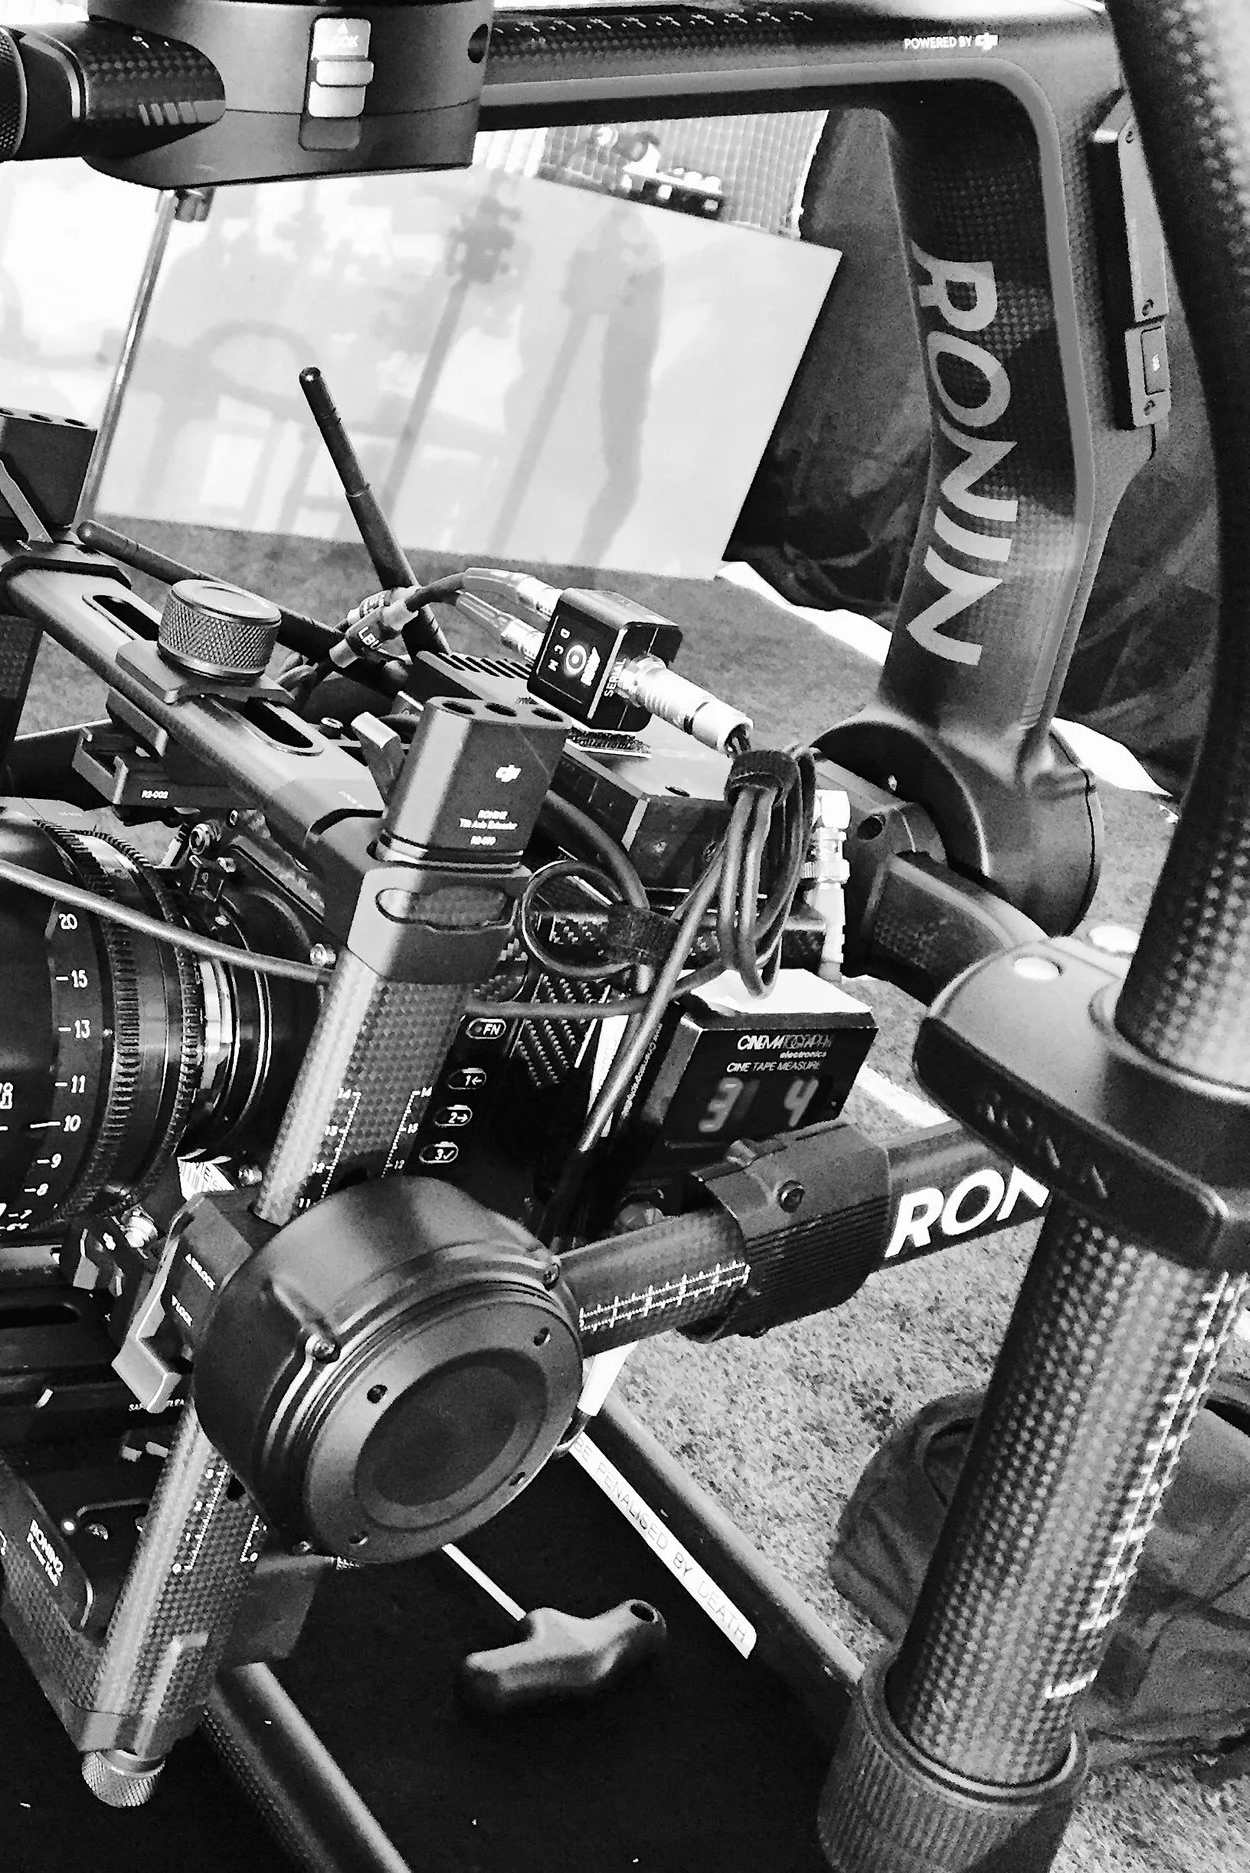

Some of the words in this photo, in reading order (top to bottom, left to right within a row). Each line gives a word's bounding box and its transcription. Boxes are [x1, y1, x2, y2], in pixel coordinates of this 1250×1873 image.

[904, 36, 958, 50] POWERED
[958, 35, 973, 48] BY
[906, 238, 1019, 667] RONIN
[58, 913, 79, 930] 20
[70, 969, 89, 989] 15
[74, 1019, 91, 1039] 13
[482, 1024, 501, 1036] FN
[726, 1062, 752, 1073] CINE
[752, 1061, 778, 1072] TAPE
[776, 1060, 821, 1071] MEASURE
[70, 1075, 87, 1094] 11
[698, 1076, 745, 1133] 3
[783, 1075, 820, 1128] 4
[63, 1114, 83, 1133] 10
[448, 1112, 458, 1124] 2
[50, 1153, 62, 1169] 9
[434, 1148, 444, 1161] 3
[36, 1183, 49, 1197] 8
[574, 1436, 593, 1464] BE
[596, 1462, 669, 1550] PENALISED
[672, 1551, 694, 1577] BY
[698, 1580, 747, 1644] DEATH
